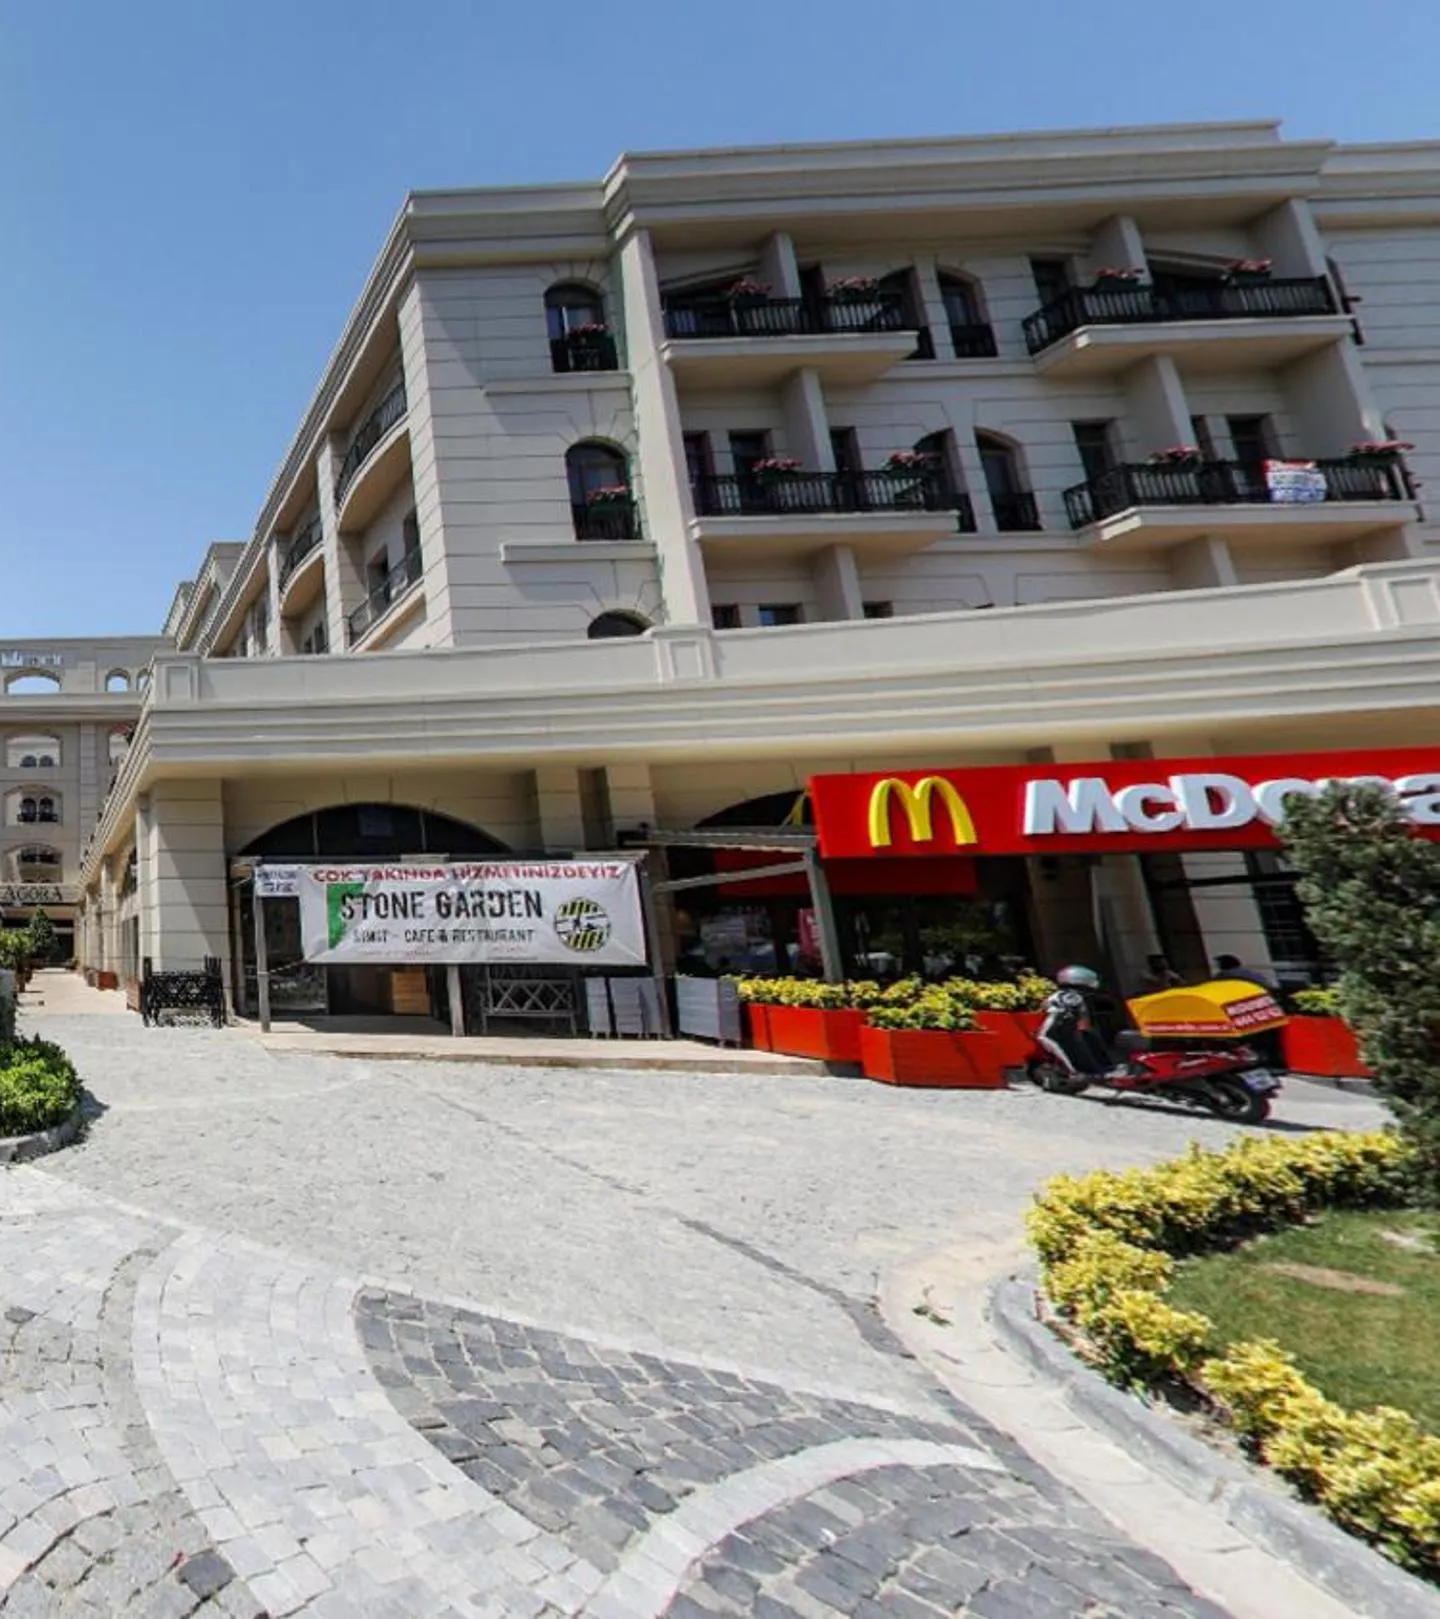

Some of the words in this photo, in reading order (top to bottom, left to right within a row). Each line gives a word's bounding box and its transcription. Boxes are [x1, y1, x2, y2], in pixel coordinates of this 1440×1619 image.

[341, 890, 426, 920] STONE
[435, 889, 544, 919] GARDEN
[404, 928, 435, 943] CAFE
[452, 928, 536, 943] RESTAURANT
